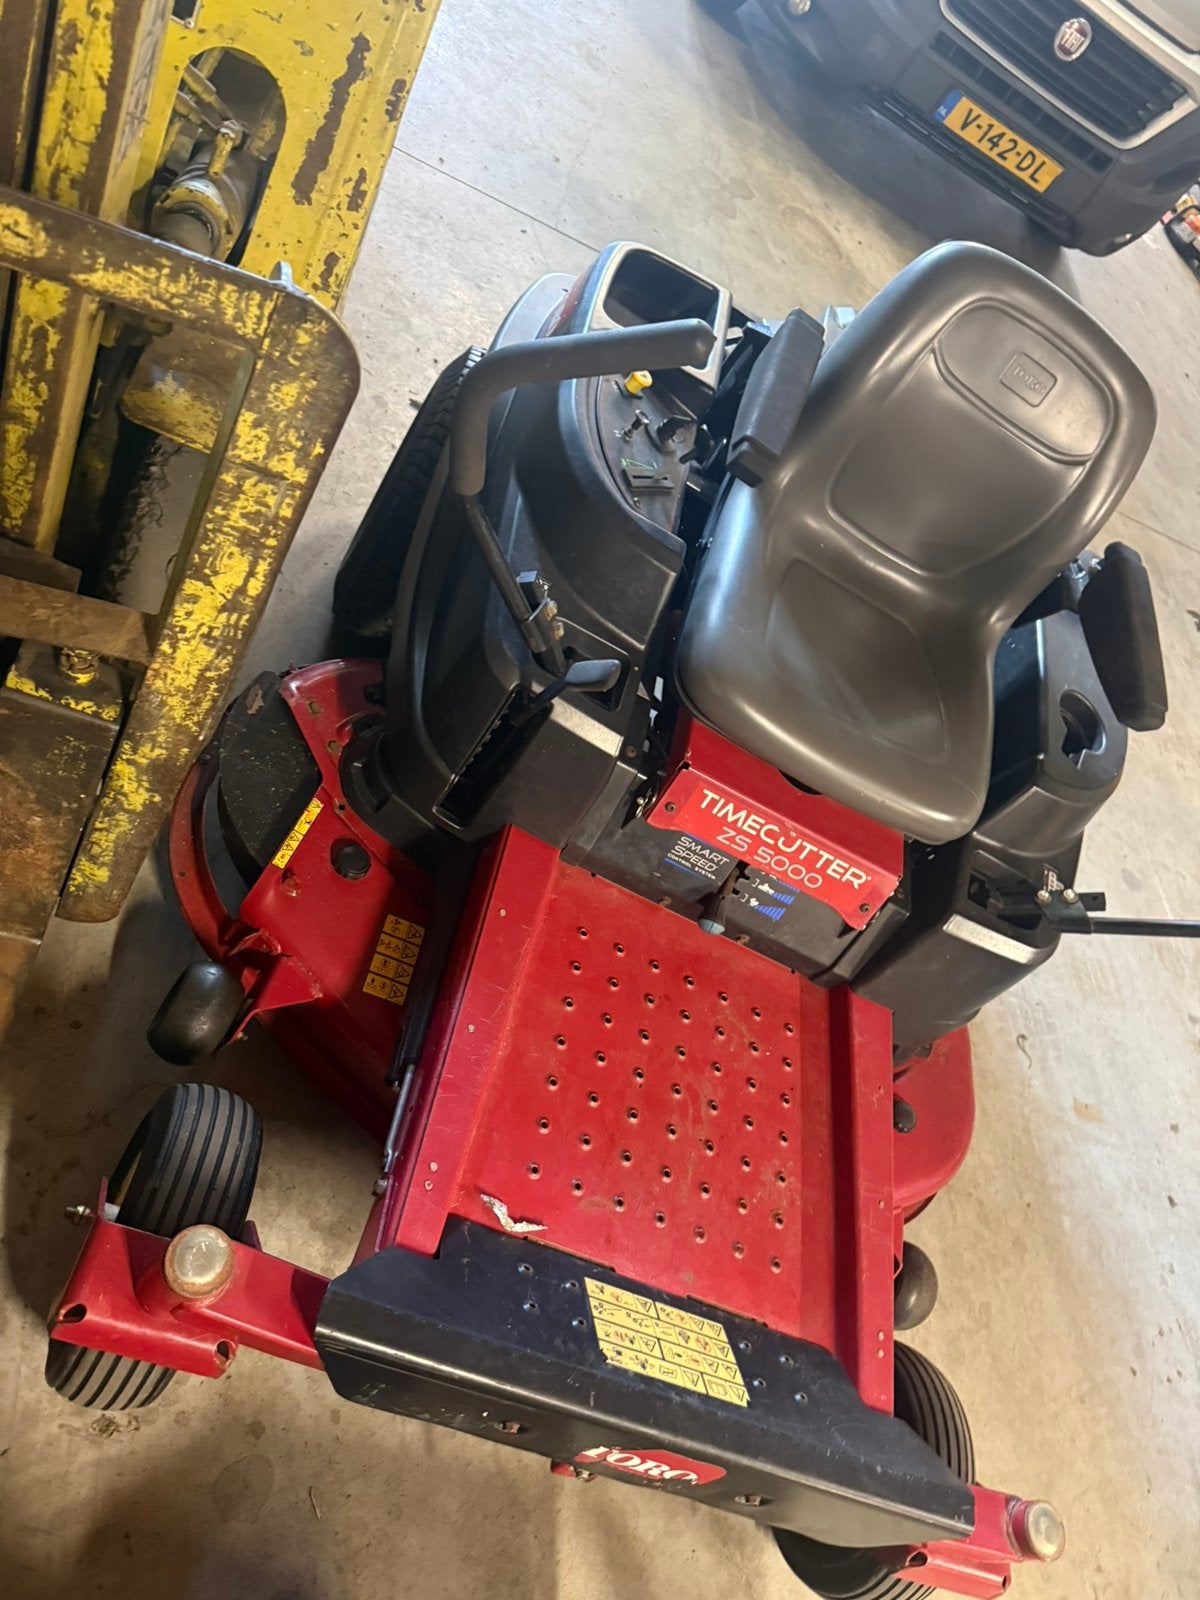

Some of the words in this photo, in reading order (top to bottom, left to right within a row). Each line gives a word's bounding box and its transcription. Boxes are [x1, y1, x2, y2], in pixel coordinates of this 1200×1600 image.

[1060, 27, 1086, 53] FIAT
[960, 108, 1047, 184] V-142-DL
[677, 836, 730, 865] SMART
[700, 789, 869, 890] TIMECUTTER
[667, 853, 692, 868] CONTROL
[694, 866, 716, 880] SYSTEM
[671, 845, 717, 871] SPEED
[716, 827, 752, 853] ZS
[752, 847, 823, 889] 5000
